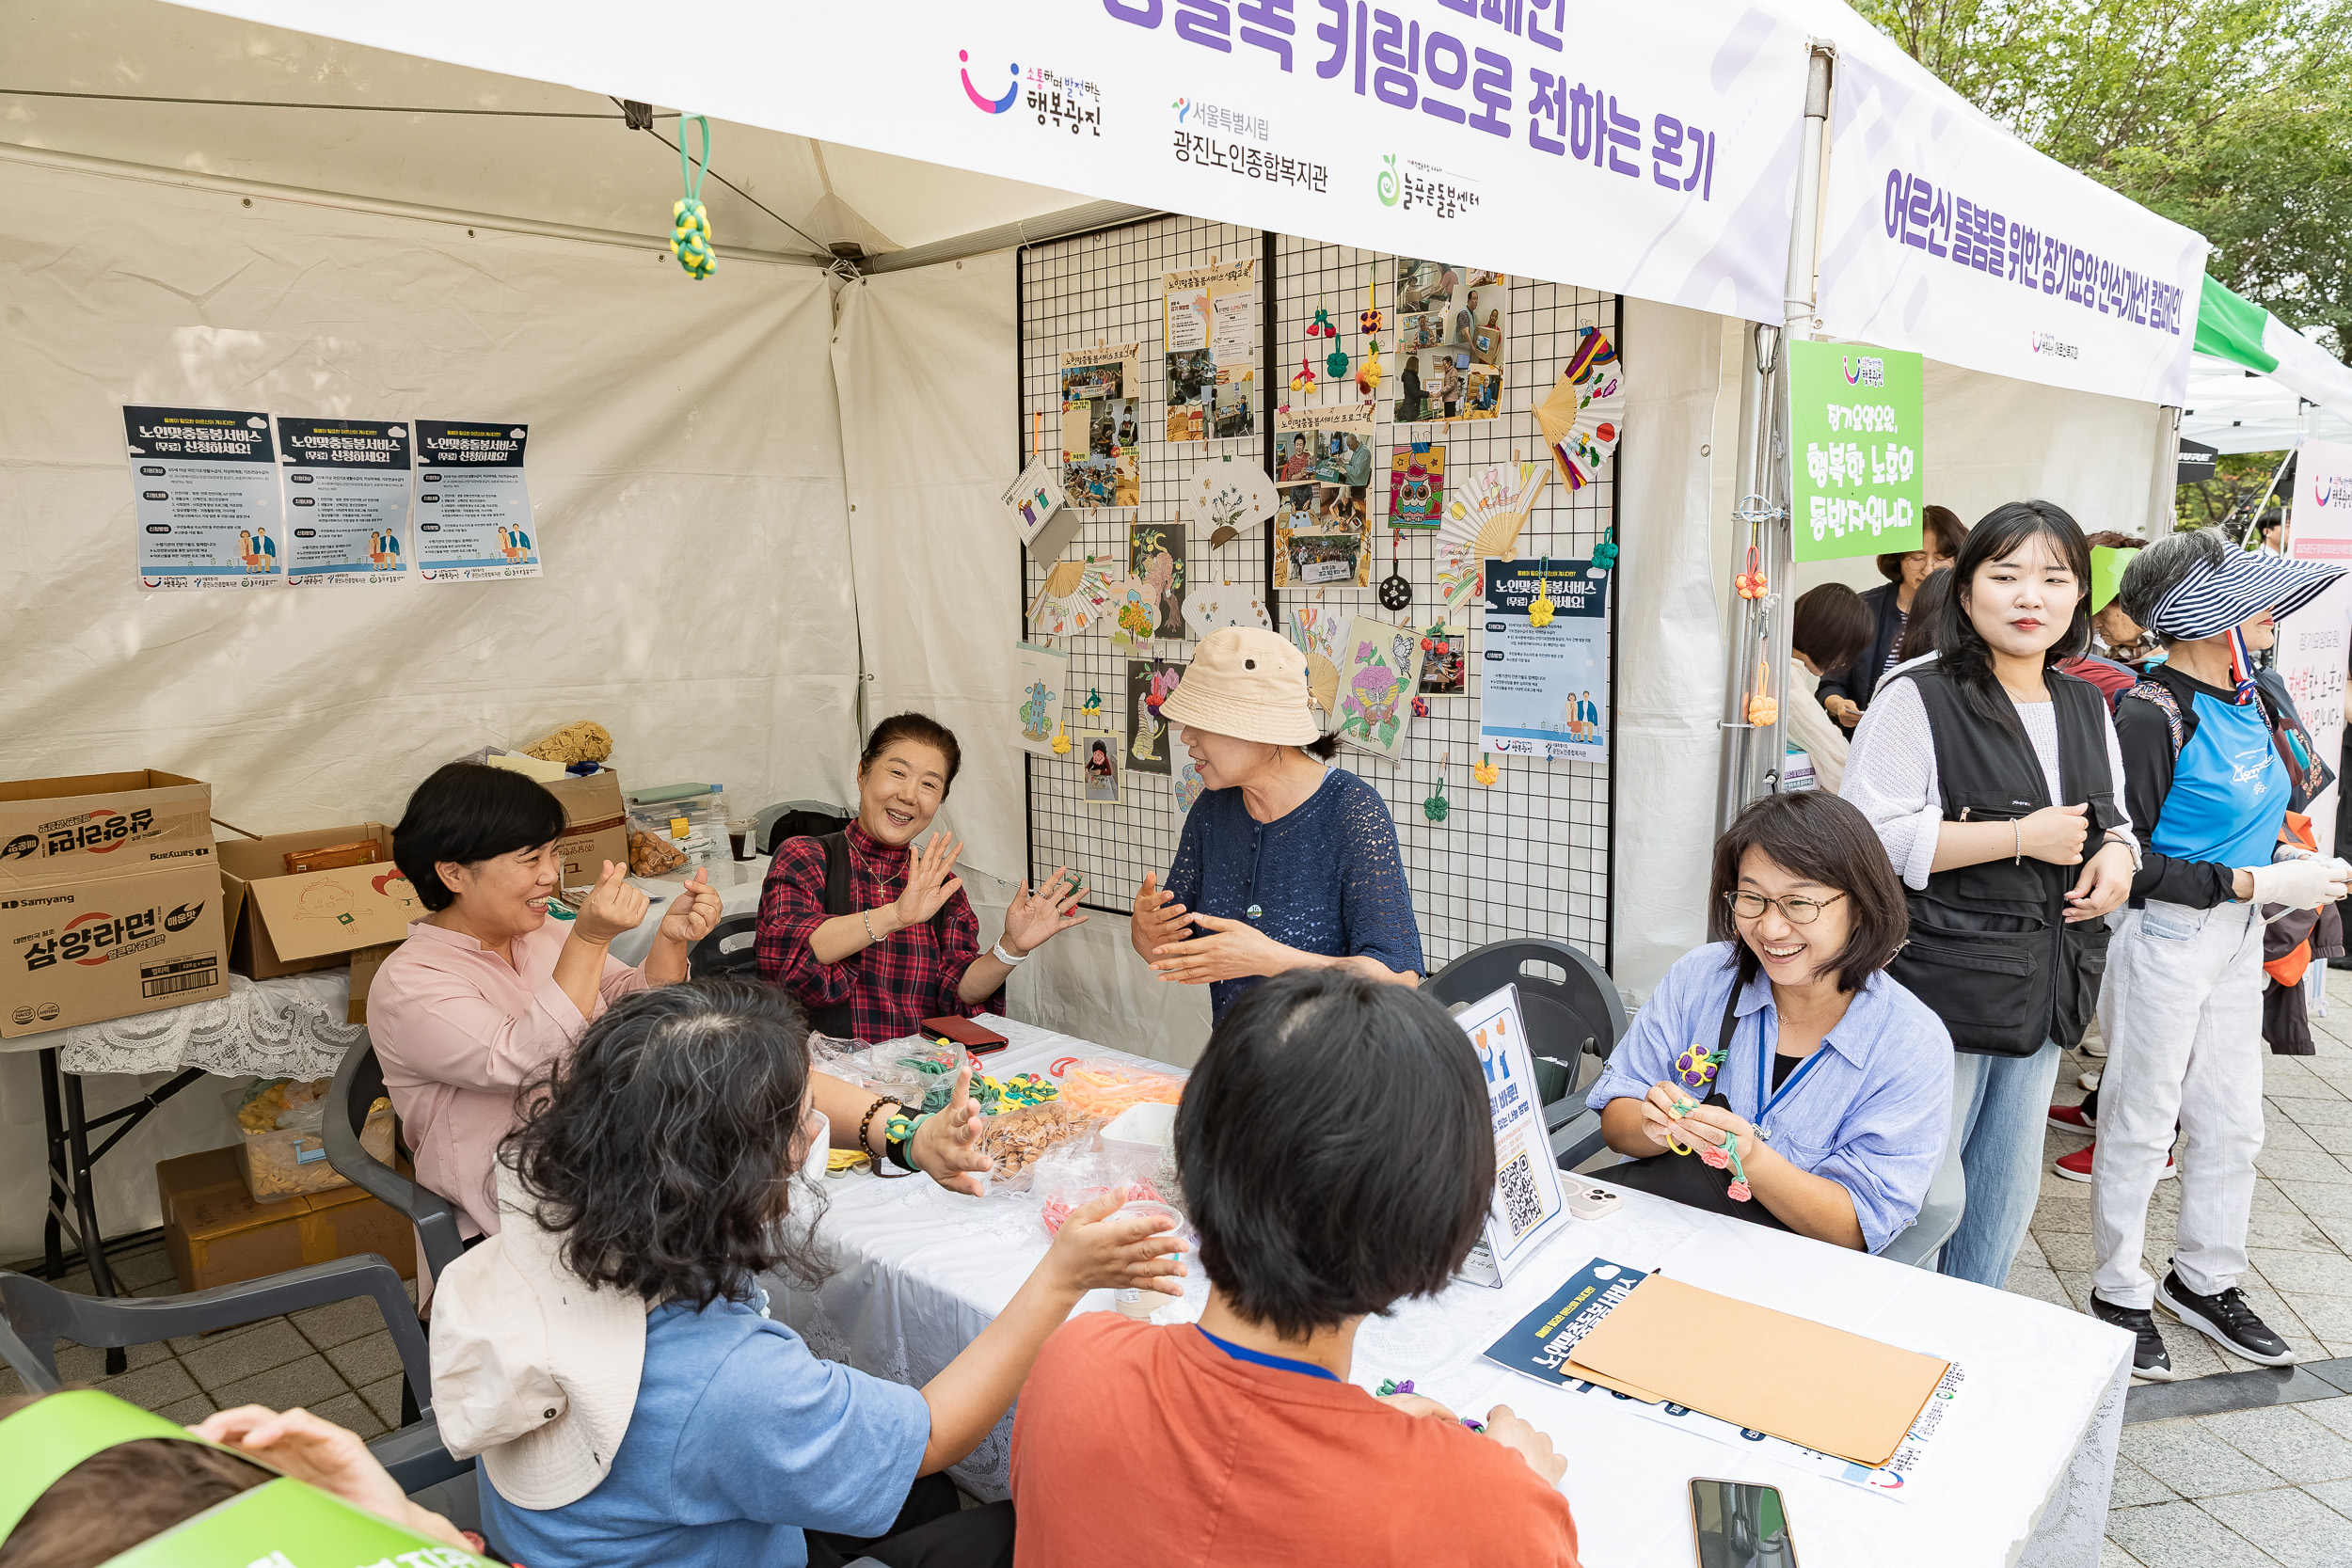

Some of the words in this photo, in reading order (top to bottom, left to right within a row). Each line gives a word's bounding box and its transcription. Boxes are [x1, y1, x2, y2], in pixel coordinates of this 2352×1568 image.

[1026, 67, 1063, 90] 소통하며
[1064, 77, 1101, 103] 발전하는
[1315, 0, 1512, 138] 키링으로
[1529, 67, 1642, 181] 전하는
[1651, 113, 1716, 202] 온기
[1026, 90, 1101, 137] 행복광진
[1193, 102, 1269, 141] 서울특별시립
[1172, 130, 1328, 194] 광진노인종합복지관
[1403, 172, 1480, 219] 늘푸른돌봄센터
[1884, 167, 1952, 258] 어르신
[1951, 195, 2007, 279] 돌봄을
[2008, 222, 2042, 286] 위한
[2042, 235, 2099, 309] 장기요양
[2098, 258, 2149, 323] 인식개선
[2150, 271, 2183, 337] 캠페인
[1827, 403, 1899, 434] 장기요양요원,
[139, 425, 262, 443] 노인맞춤돌봄서비스
[291, 436, 401, 451] 노인맞춤돌봄서비스
[426, 437, 518, 451] 노인맞춤돌봄서비스
[155, 442, 182, 452] (무료)
[183, 442, 251, 454] 신청하세요!
[305, 451, 328, 461] (무료)
[330, 450, 390, 463] 신청하세요!
[437, 451, 457, 461] (무료)
[458, 451, 508, 462] 신청하세요!
[1806, 441, 1867, 490] 행복한
[1871, 444, 1915, 488] 노후의
[1809, 494, 1914, 543] 동반자입니다
[1506, 596, 1528, 607] (무료)
[1530, 594, 1585, 610] 하세요!
[48, 808, 154, 856] 삼양라면
[8, 839, 38, 853] 매운맛
[151, 849, 195, 861] Samyang
[20, 895, 75, 908] Samyang
[167, 911, 197, 927] 매운맛
[13, 932, 40, 944] 대한민국
[41, 928, 56, 938] 최초
[24, 908, 156, 972] 삼양라면
[106, 943, 136, 961] 얼큰한
[151, 965, 170, 975] 멀티팩
[1499, 1082, 1519, 1110] 바로!
[1497, 1117, 1509, 1132] 있는
[1507, 1109, 1519, 1123] 나눔
